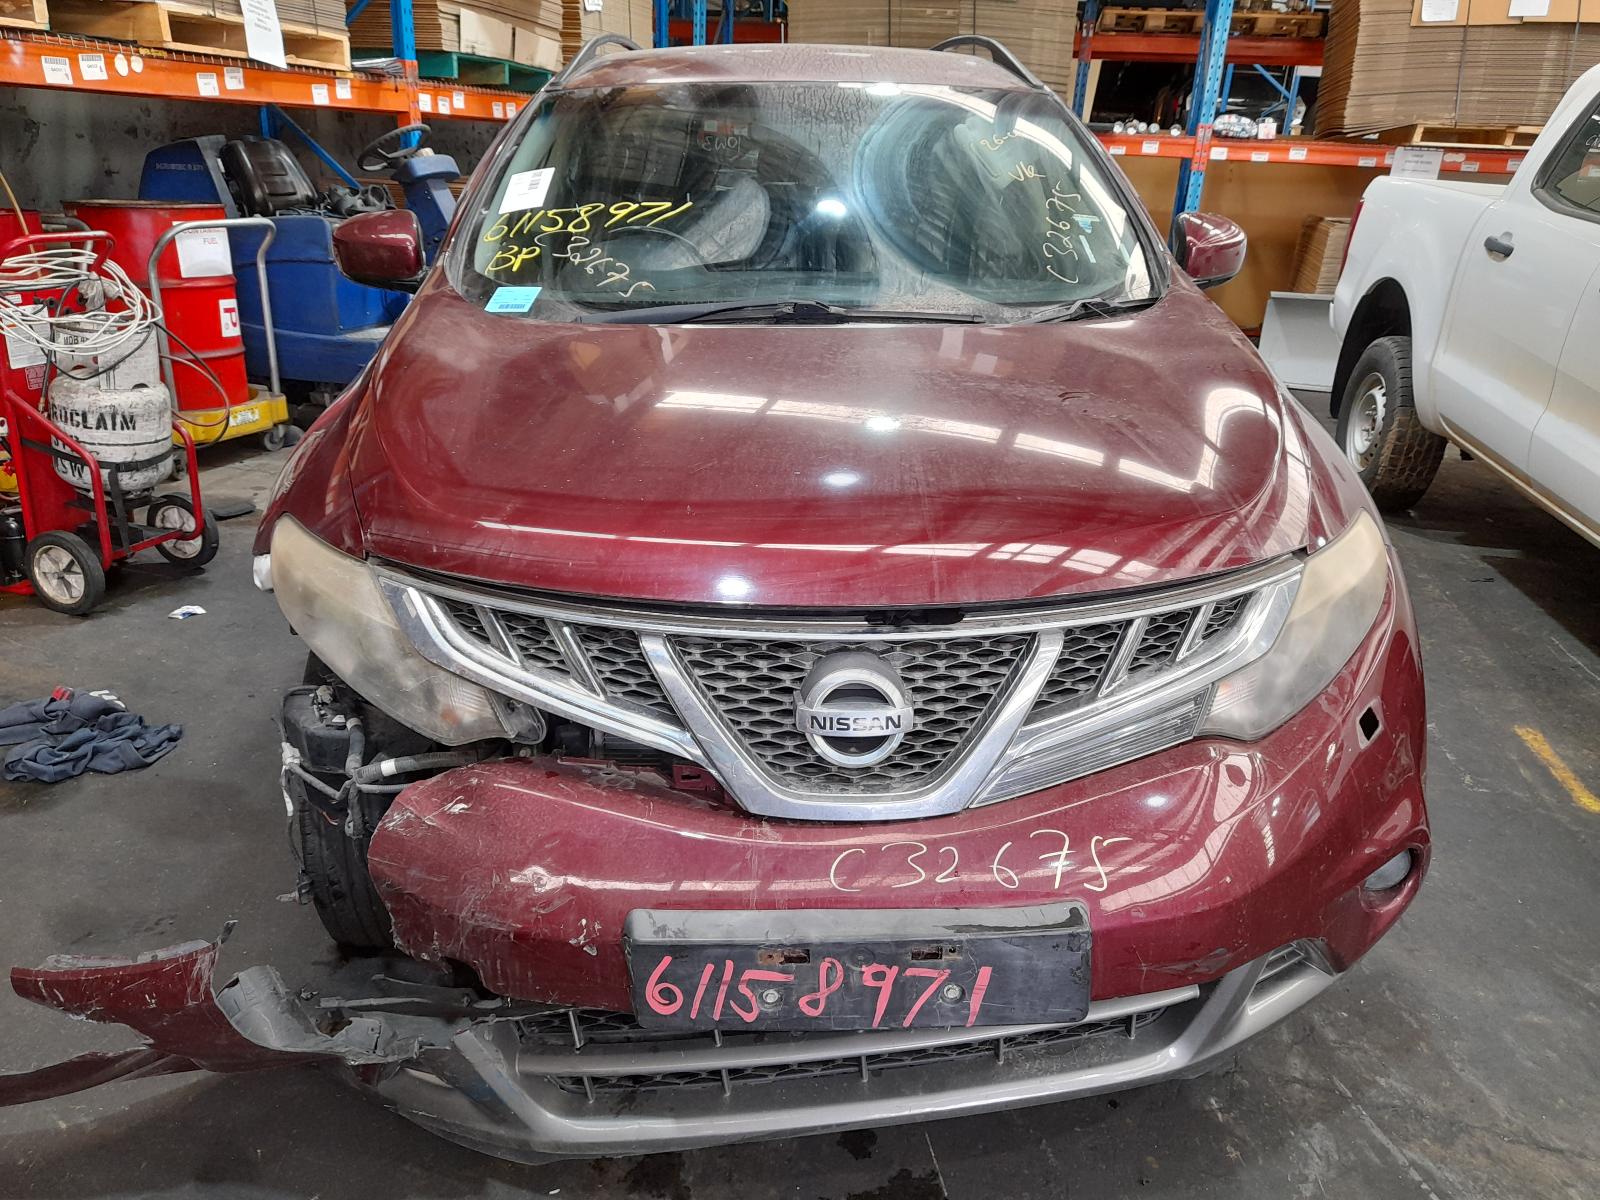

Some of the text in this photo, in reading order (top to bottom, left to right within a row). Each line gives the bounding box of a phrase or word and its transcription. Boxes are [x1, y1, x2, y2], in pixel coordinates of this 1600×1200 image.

[483, 201, 694, 242] 61158971
[810, 714, 901, 731] NISSAN
[829, 829, 1133, 892] C32675
[645, 955, 993, 1028] 61158971
